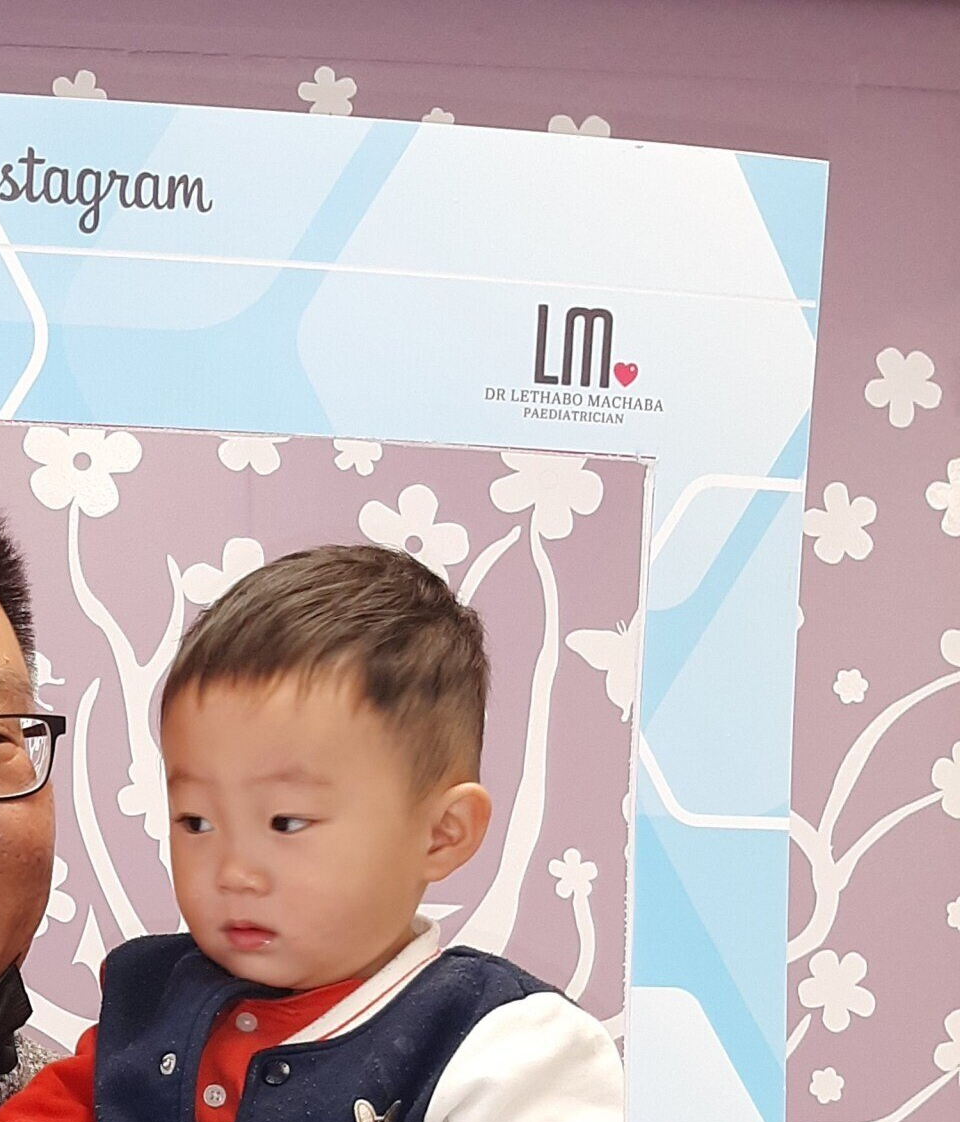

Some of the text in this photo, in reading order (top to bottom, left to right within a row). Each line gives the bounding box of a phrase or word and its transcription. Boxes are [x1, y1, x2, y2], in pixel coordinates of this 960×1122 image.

[485, 388, 664, 412] DR LETHABO MACHABA
[523, 407, 624, 424] PAEDIATRICIAN
